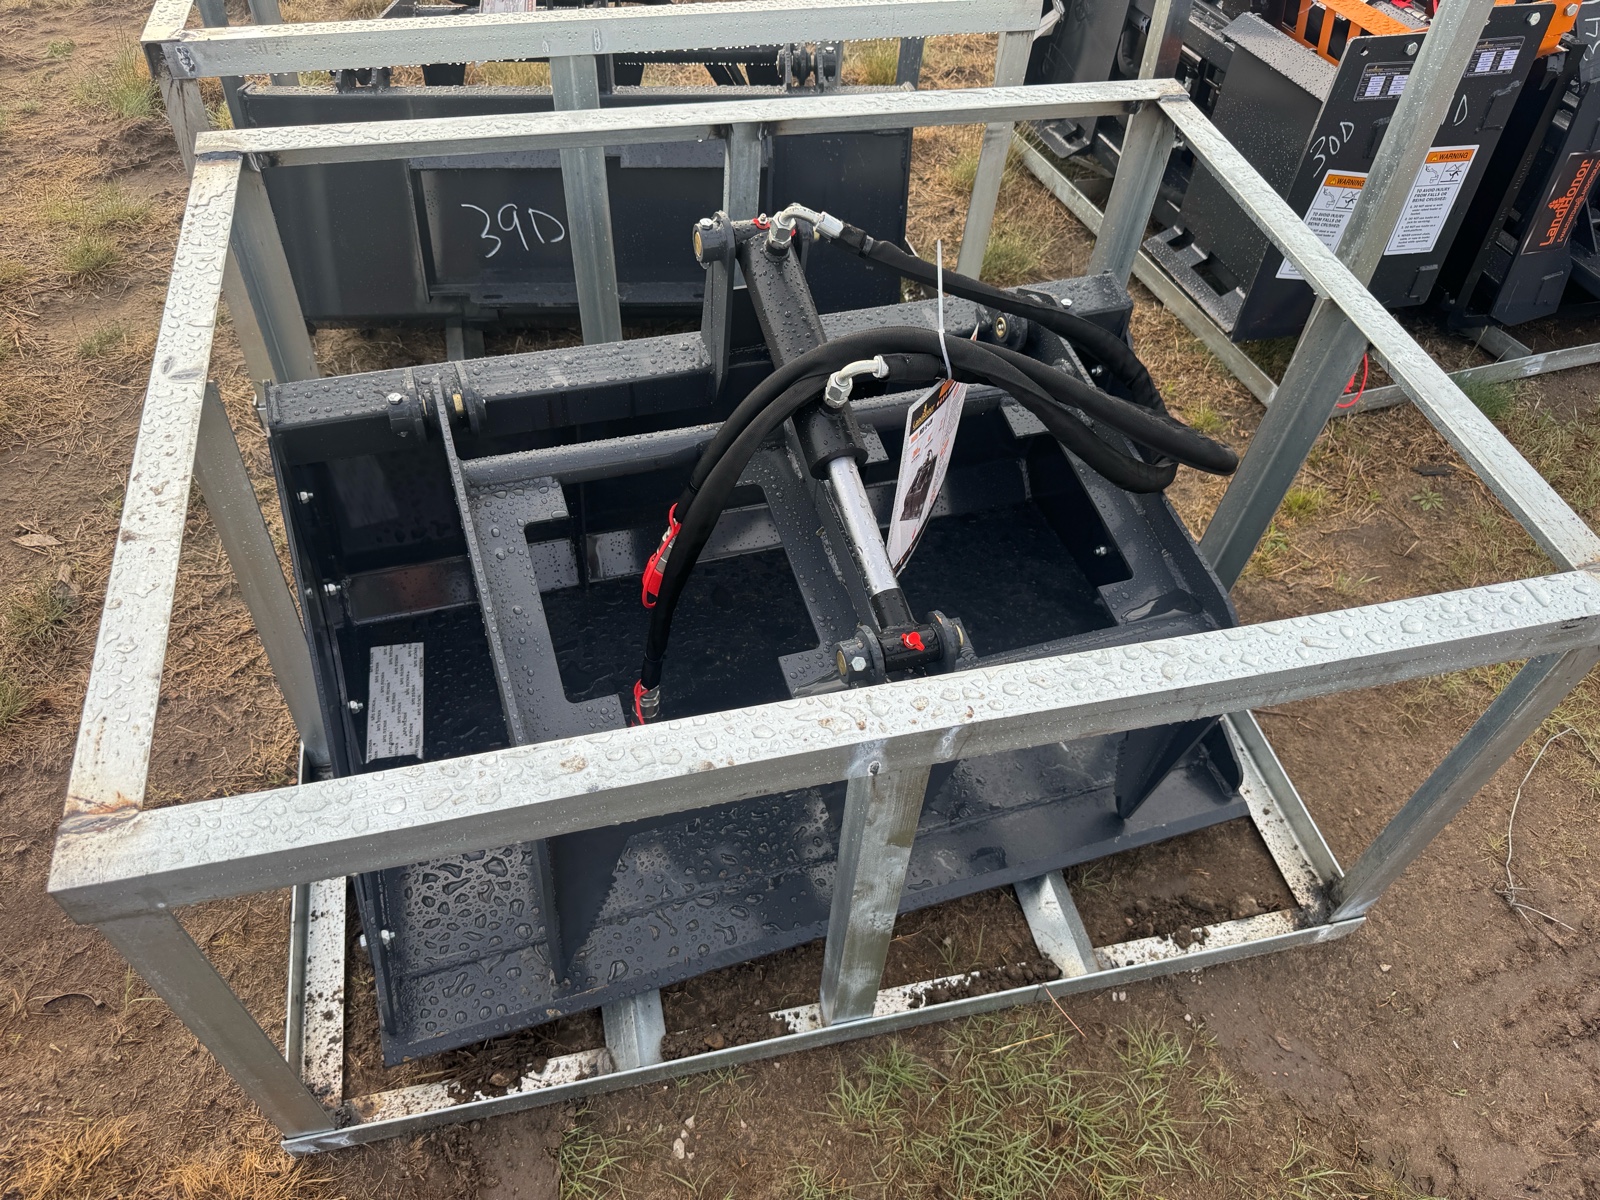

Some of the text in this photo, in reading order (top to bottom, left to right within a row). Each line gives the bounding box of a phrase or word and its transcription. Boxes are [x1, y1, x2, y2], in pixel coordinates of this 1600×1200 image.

[1310, 121, 1354, 178] 30D
[1438, 152, 1469, 161] WARNING
[1337, 177, 1365, 187] WARNING
[1539, 159, 1593, 247] LandHonor
[461, 203, 565, 258] 39D
